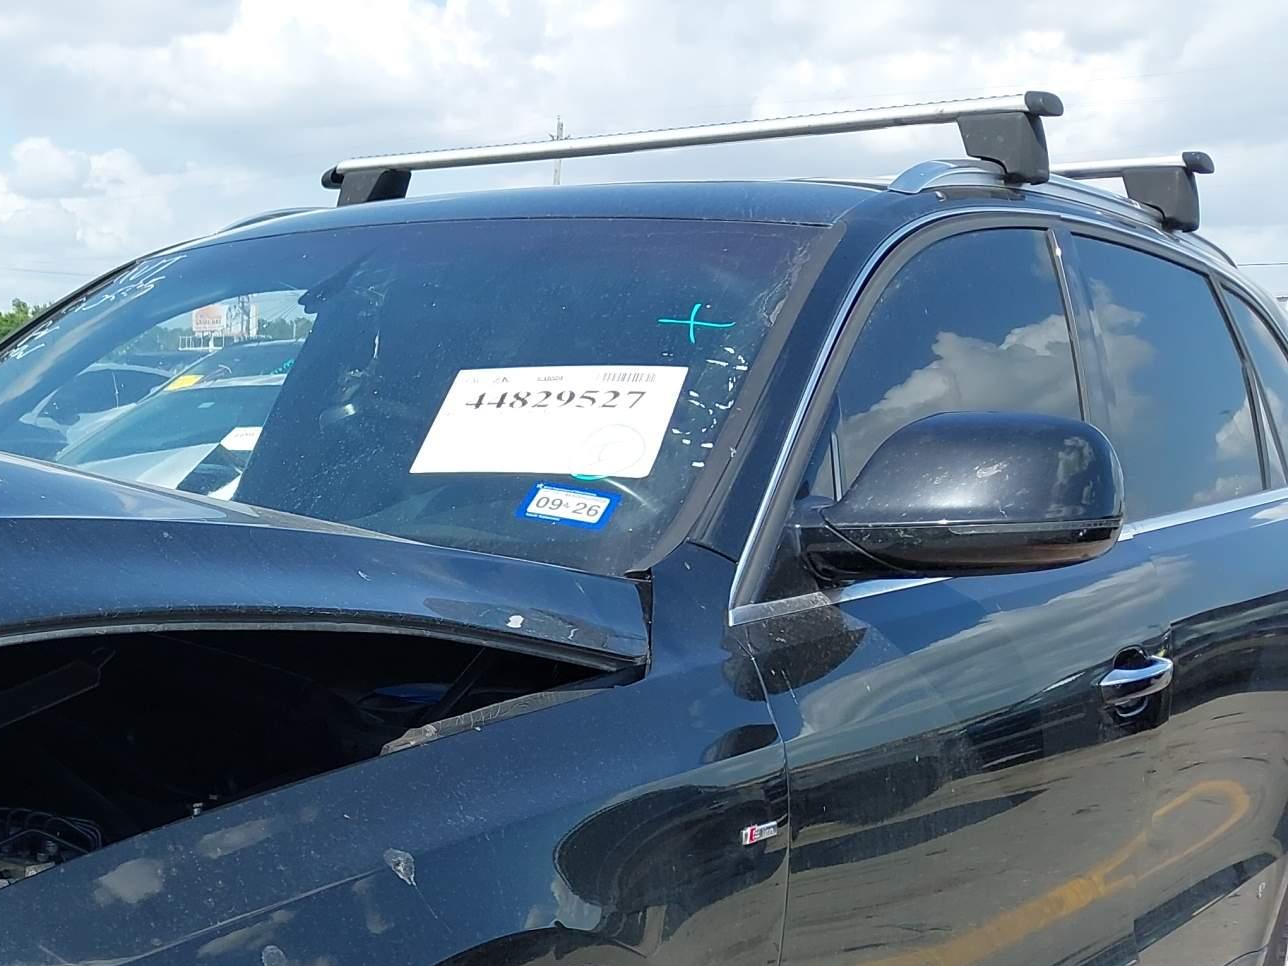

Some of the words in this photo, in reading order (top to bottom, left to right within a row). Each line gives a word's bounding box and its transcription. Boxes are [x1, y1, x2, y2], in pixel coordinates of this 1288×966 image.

[466, 390, 647, 410] 44829527
[536, 496, 562, 512] 09
[572, 503, 601, 517] 26
